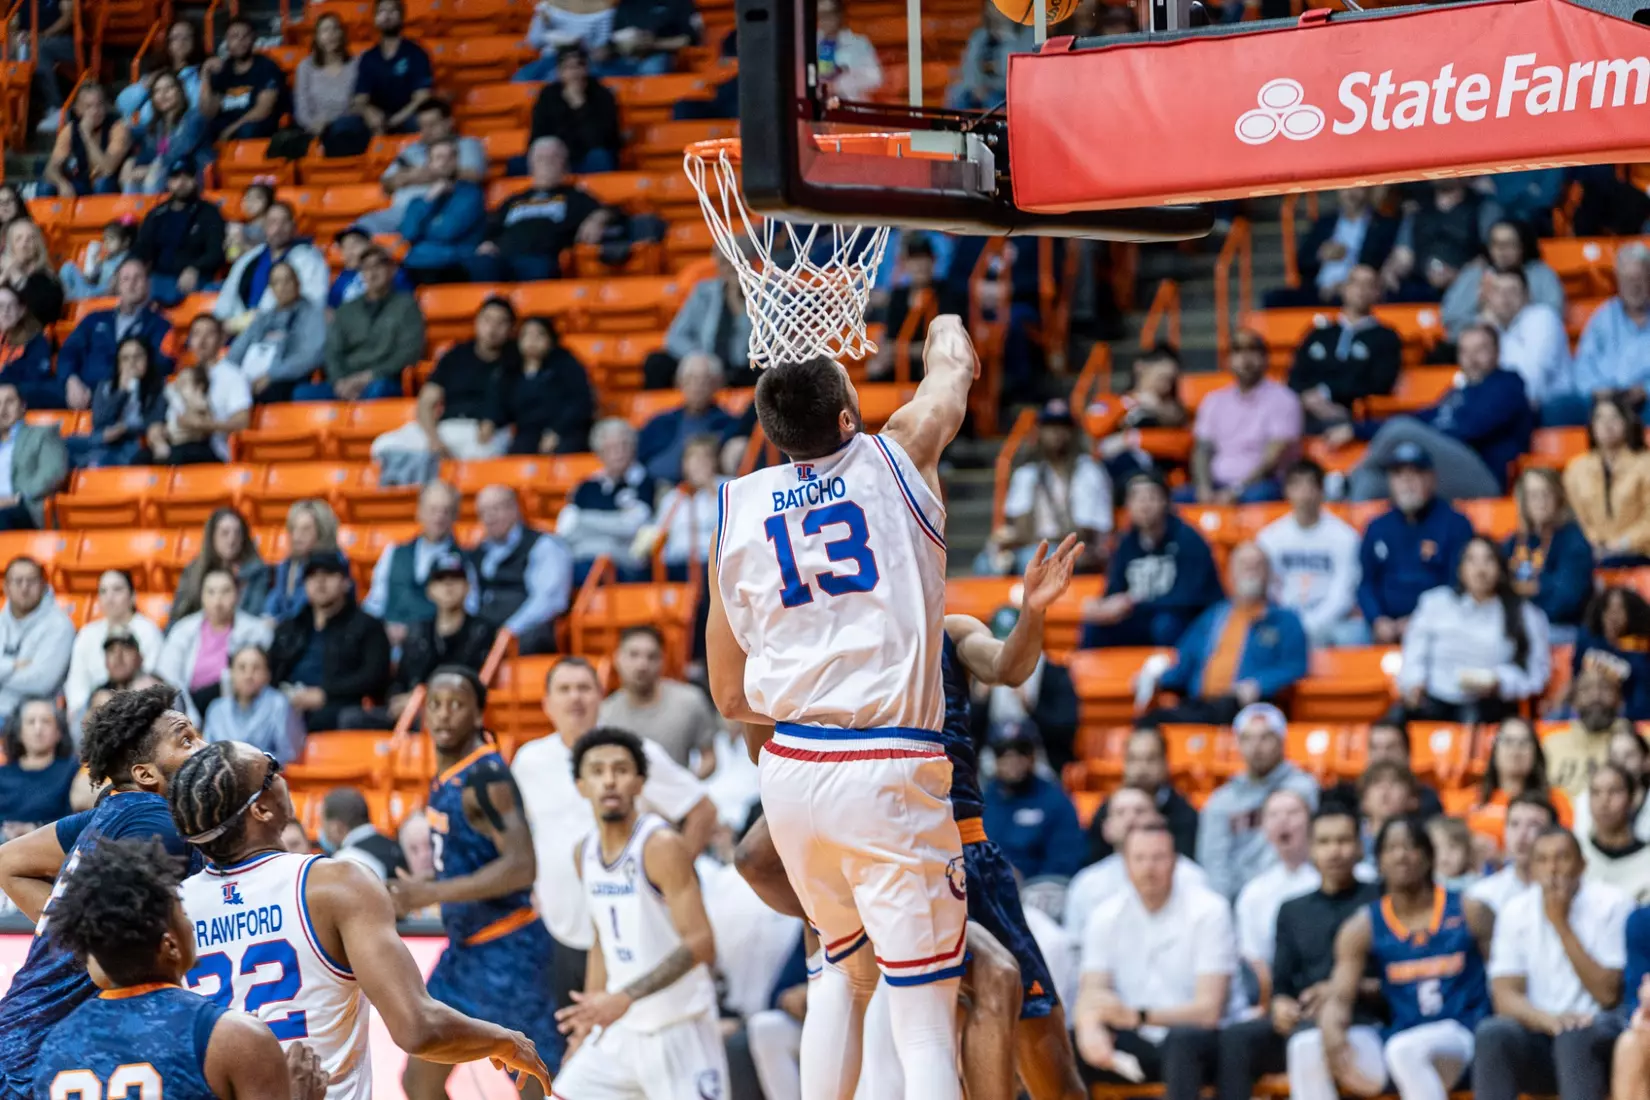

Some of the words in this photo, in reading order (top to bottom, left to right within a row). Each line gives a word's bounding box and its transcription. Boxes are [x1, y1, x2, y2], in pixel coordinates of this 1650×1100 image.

[772, 476, 846, 512] BATCHO
[764, 500, 880, 608] 13
[192, 904, 283, 948] RAWFORD
